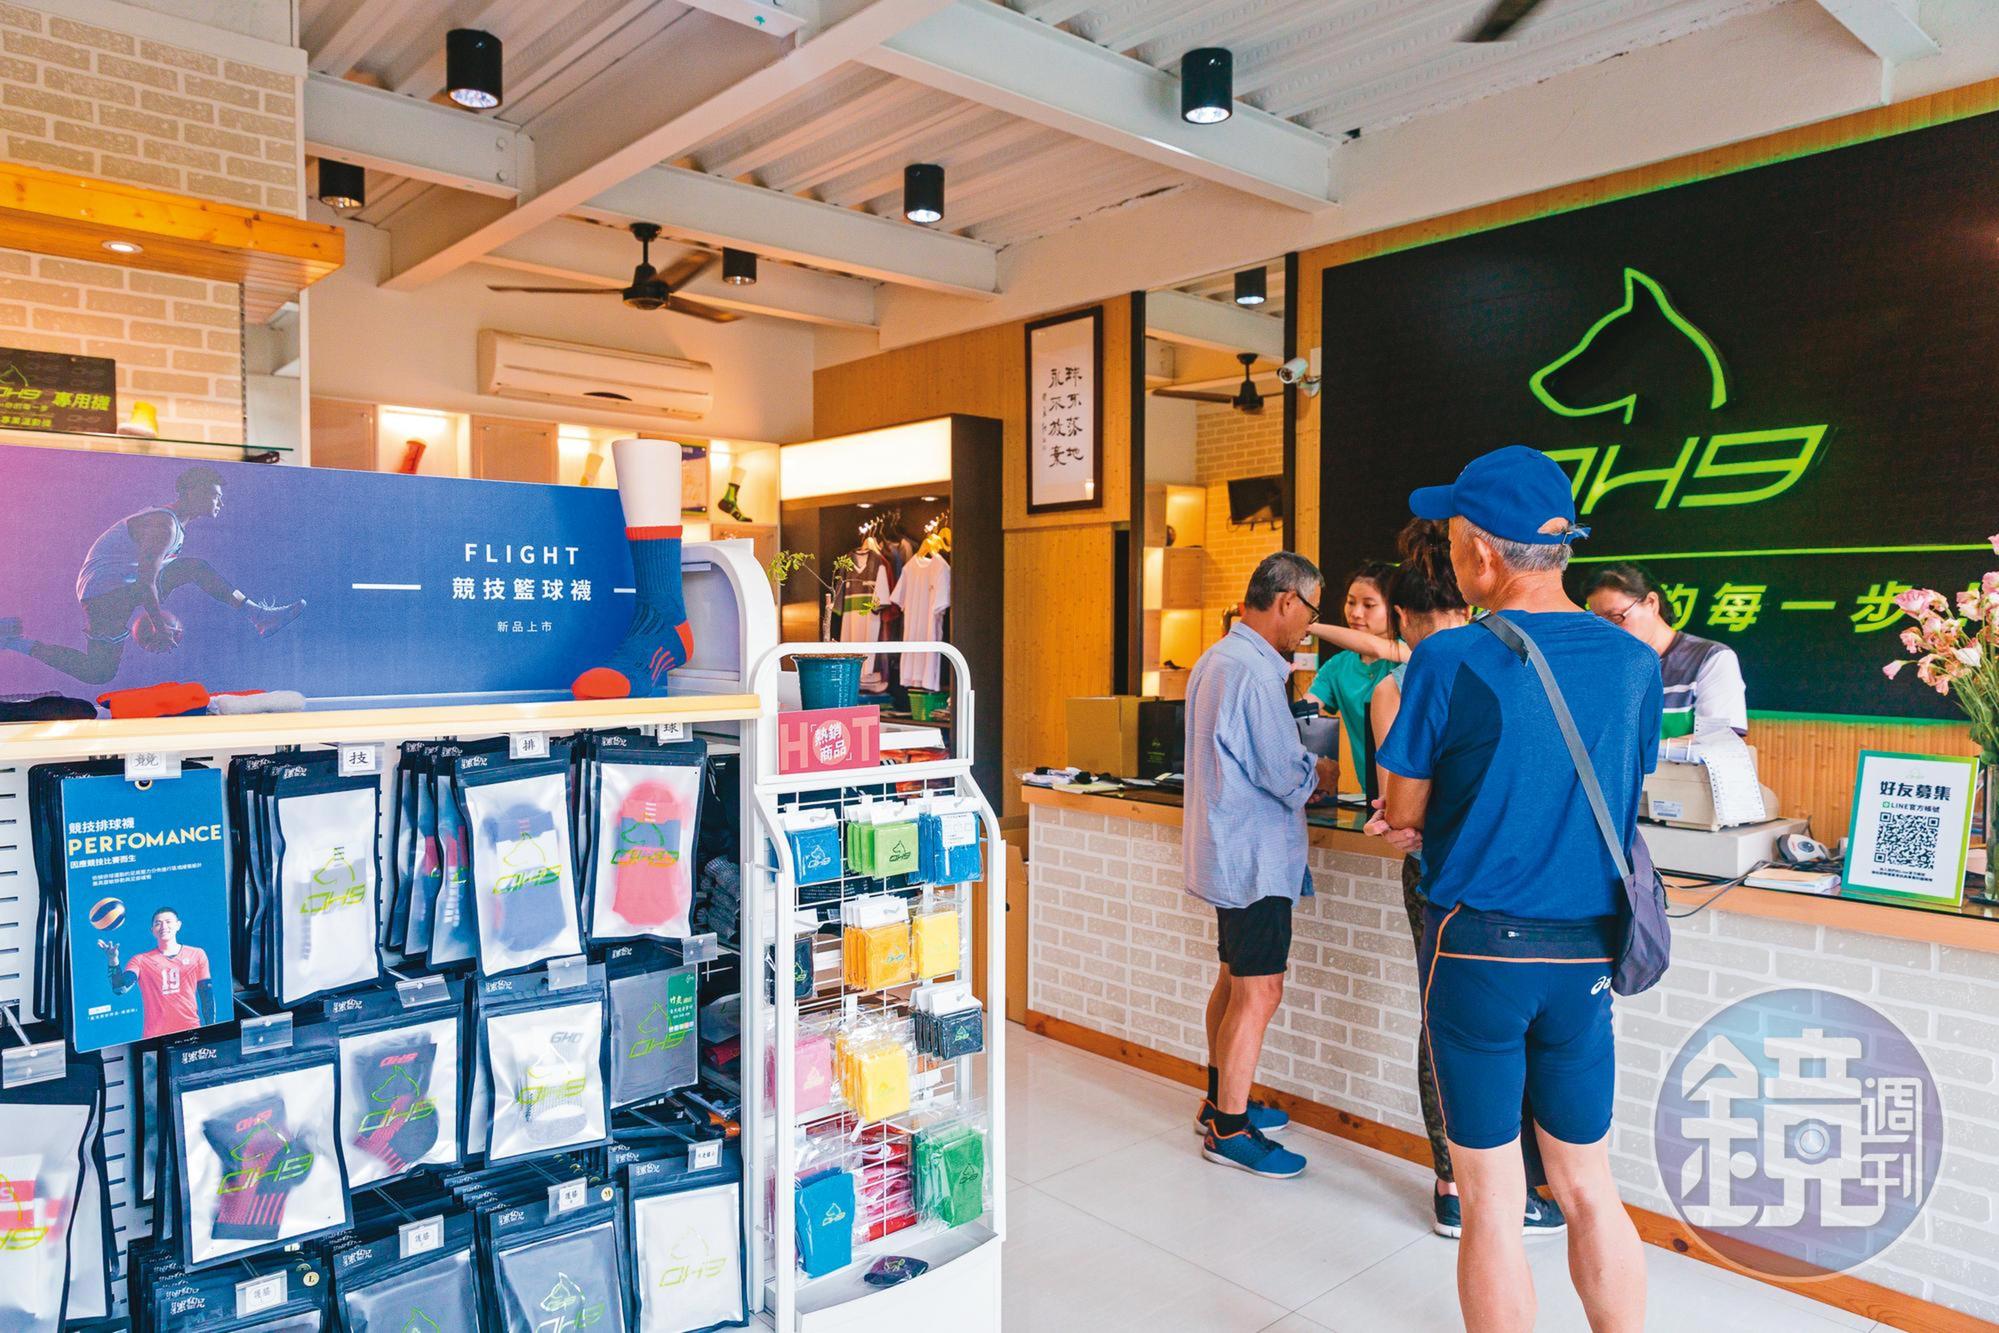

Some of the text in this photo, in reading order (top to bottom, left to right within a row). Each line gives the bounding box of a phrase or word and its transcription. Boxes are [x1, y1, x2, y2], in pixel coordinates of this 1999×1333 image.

[465, 543, 579, 565] FLIGHT
[452, 577, 592, 601] 競技籃球襪
[497, 621, 552, 633] 新品上市
[814, 721, 843, 748] 熱銷
[348, 751, 370, 765] 技
[819, 741, 848, 764] 商品
[1880, 781, 1951, 801] 好友募集
[68, 817, 135, 835] 競技排球襪
[68, 824, 222, 856] PERFOMANCE
[161, 968, 181, 989] 19
